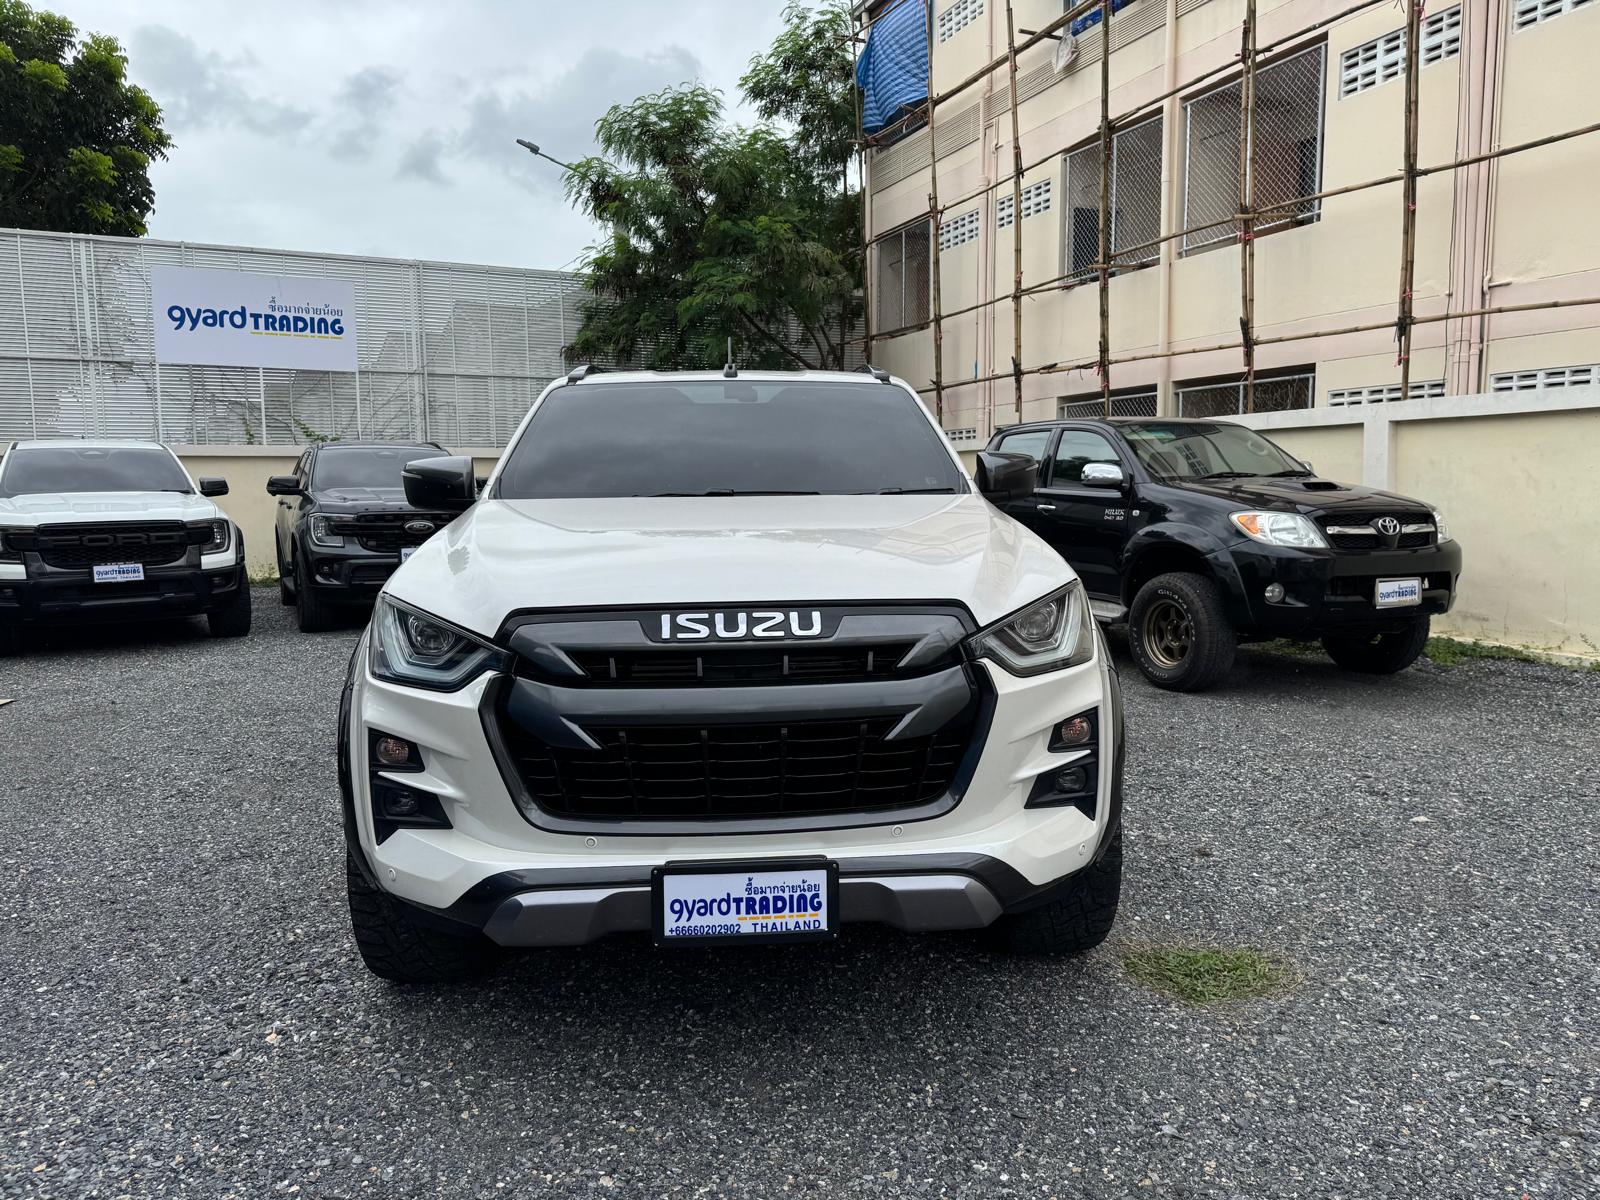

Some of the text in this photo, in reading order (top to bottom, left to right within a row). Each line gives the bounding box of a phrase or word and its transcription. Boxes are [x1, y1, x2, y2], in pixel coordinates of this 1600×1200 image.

[661, 611, 822, 640] ISUZU
[668, 919, 821, 936] +66660202902 THAILAND
